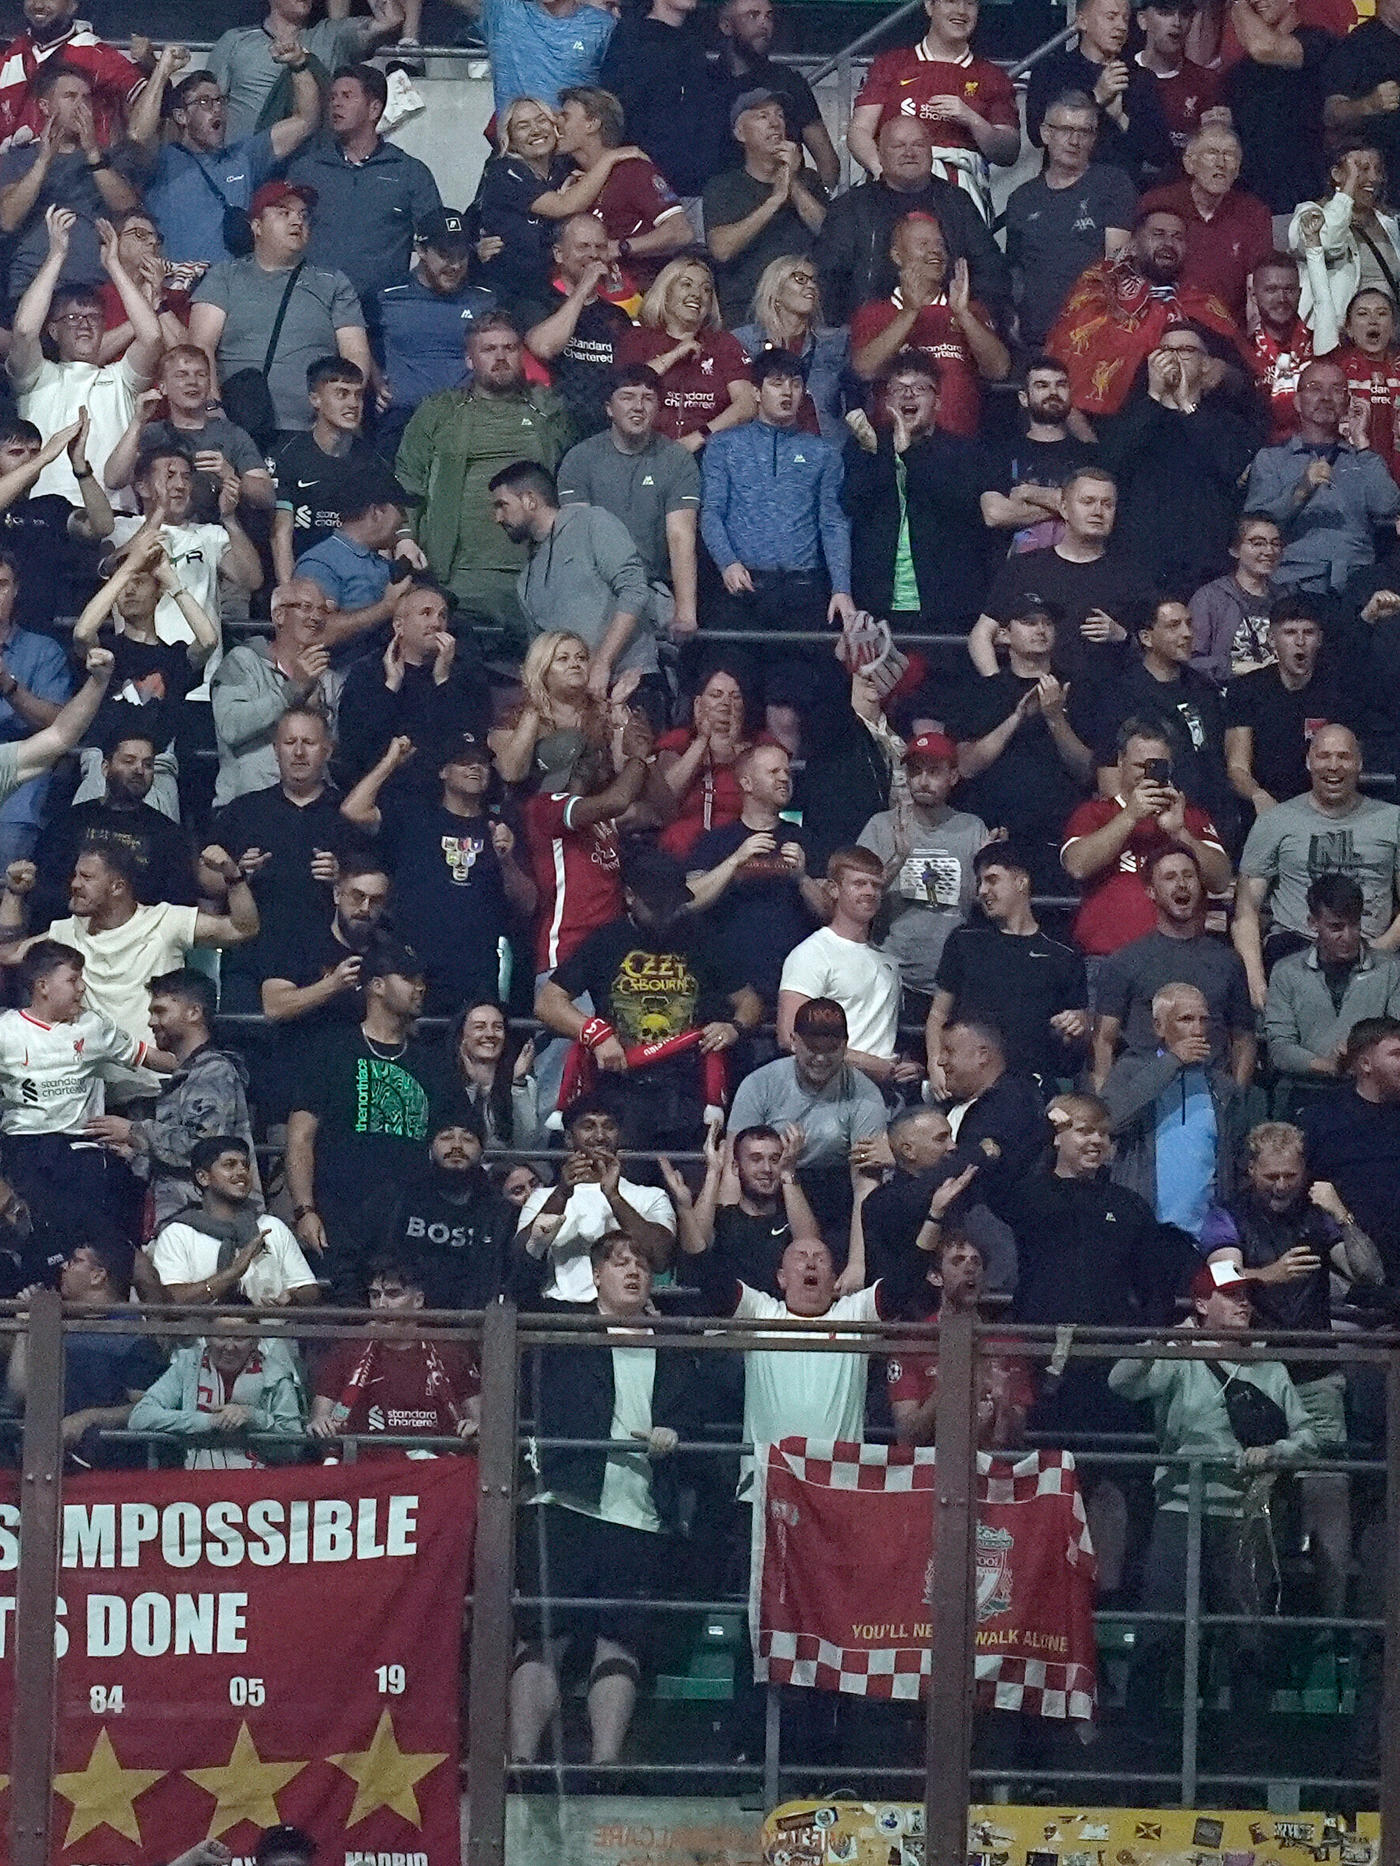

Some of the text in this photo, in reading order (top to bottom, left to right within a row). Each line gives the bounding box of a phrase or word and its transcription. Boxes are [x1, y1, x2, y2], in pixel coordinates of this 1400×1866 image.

[563, 348, 613, 363] Chartered
[568, 337, 612, 353] Standard
[387, 1409, 437, 1420] standard
[388, 1417, 438, 1427] chartered
[62, 1495, 419, 1569] MPOSSIBLE
[87, 1591, 248, 1657] DONE
[851, 1624, 908, 1639] YOU'LL
[1023, 1629, 1069, 1653] ALONE
[229, 1676, 266, 1707] 05
[374, 1664, 406, 1695] 19
[89, 1685, 126, 1713] 84
